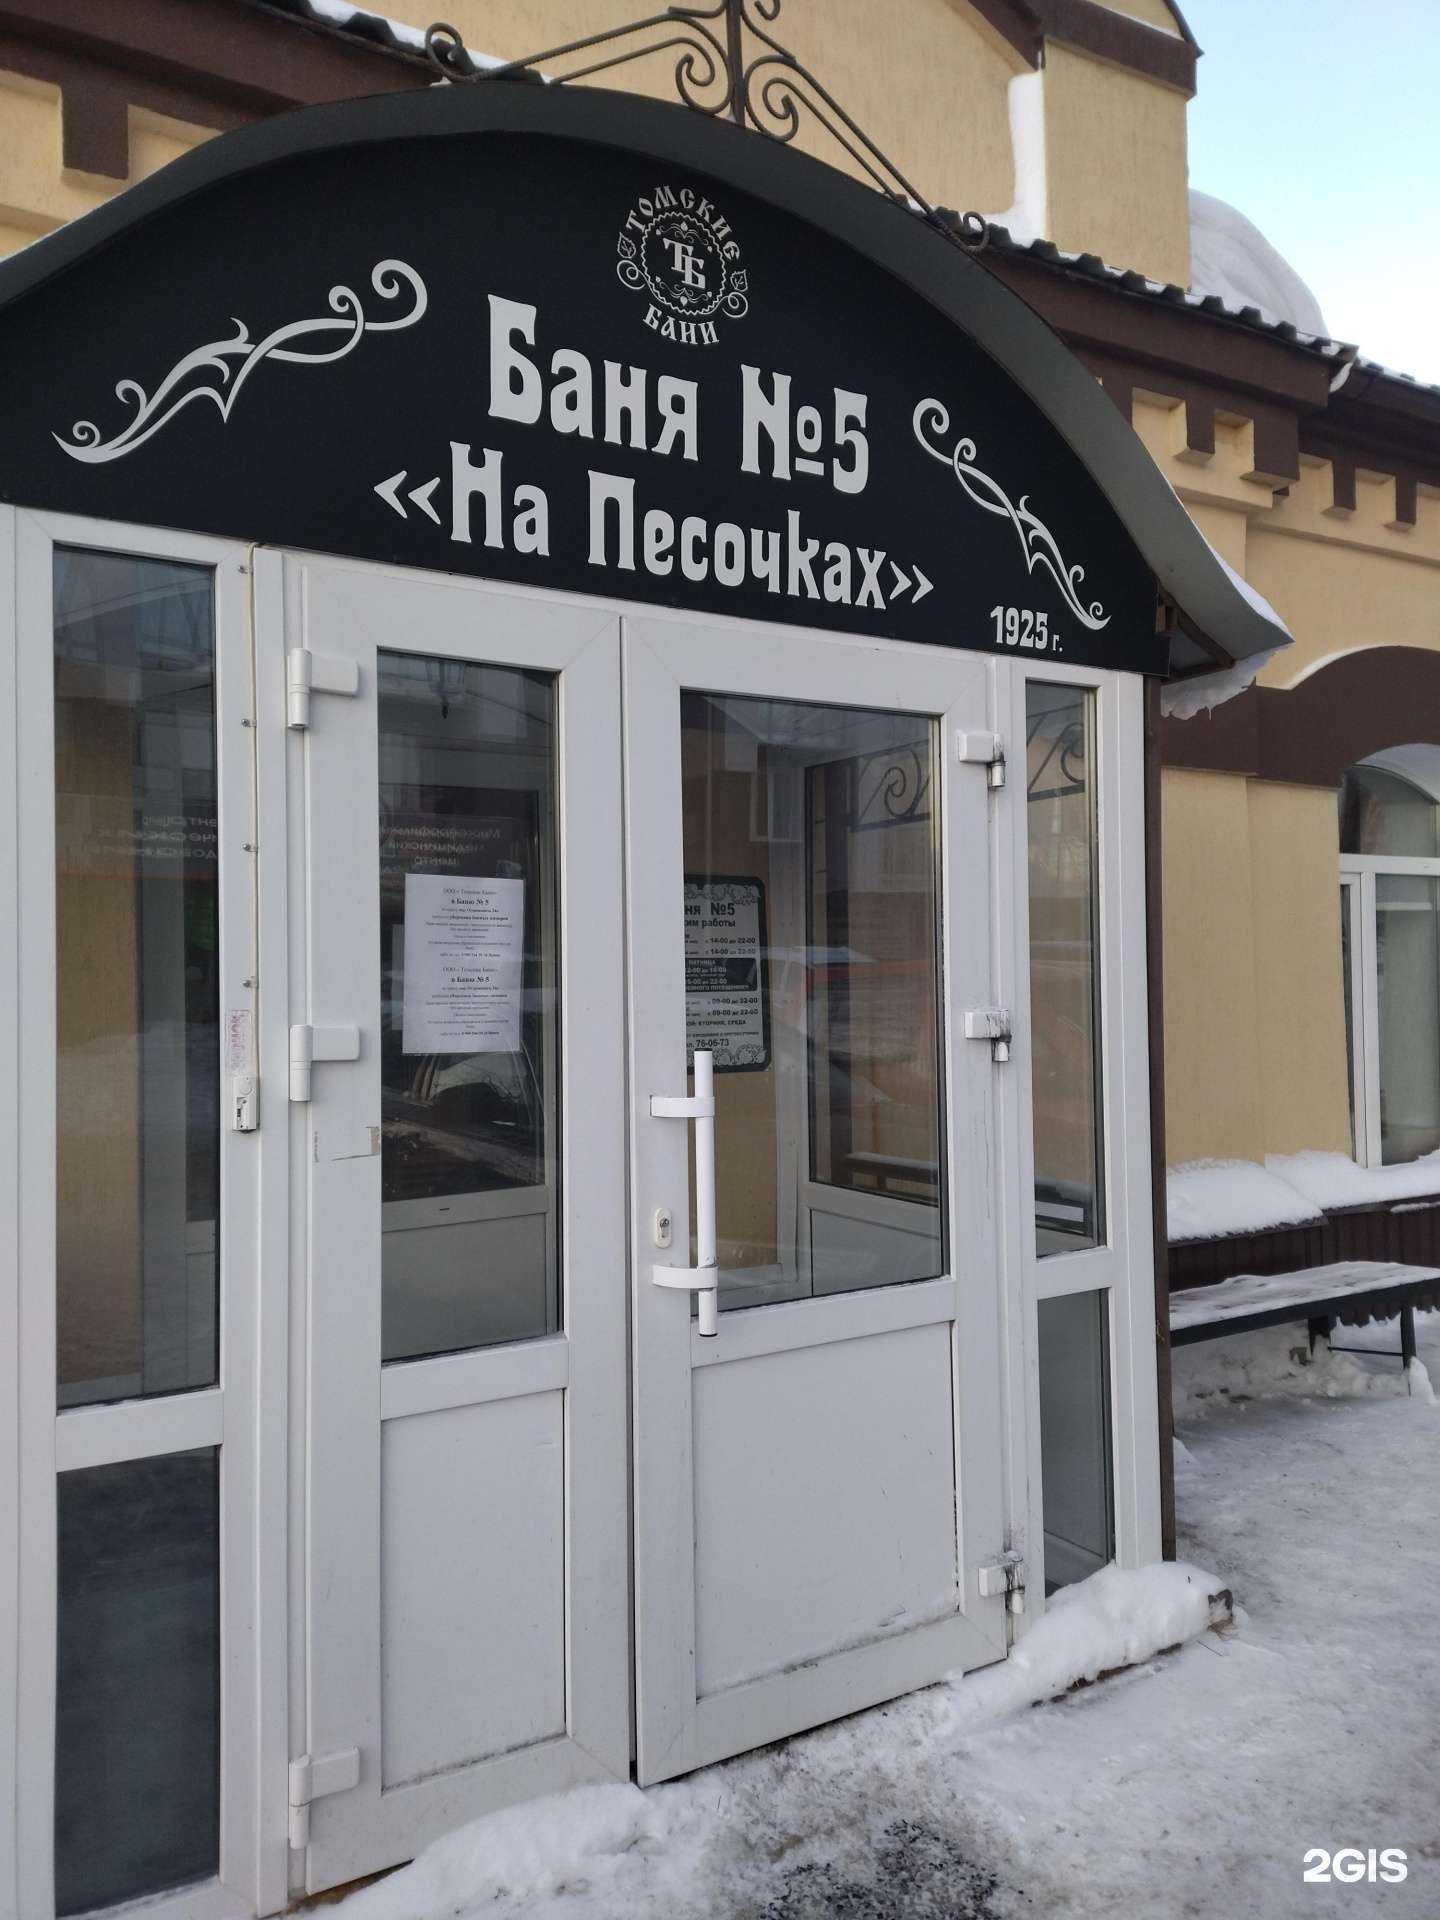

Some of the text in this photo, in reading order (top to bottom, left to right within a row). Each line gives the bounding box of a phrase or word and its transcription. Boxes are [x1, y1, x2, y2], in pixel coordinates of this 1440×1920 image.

[626, 185, 741, 261] ТОМСКИЕ
[642, 303, 720, 345] БАНИ
[487, 293, 869, 494] Баня №5
[587, 469, 934, 610] Песочках»
[990, 605, 1063, 652] 1925 г.
[684, 902, 736, 916] ня №5
[702, 918, 737, 929] работы
